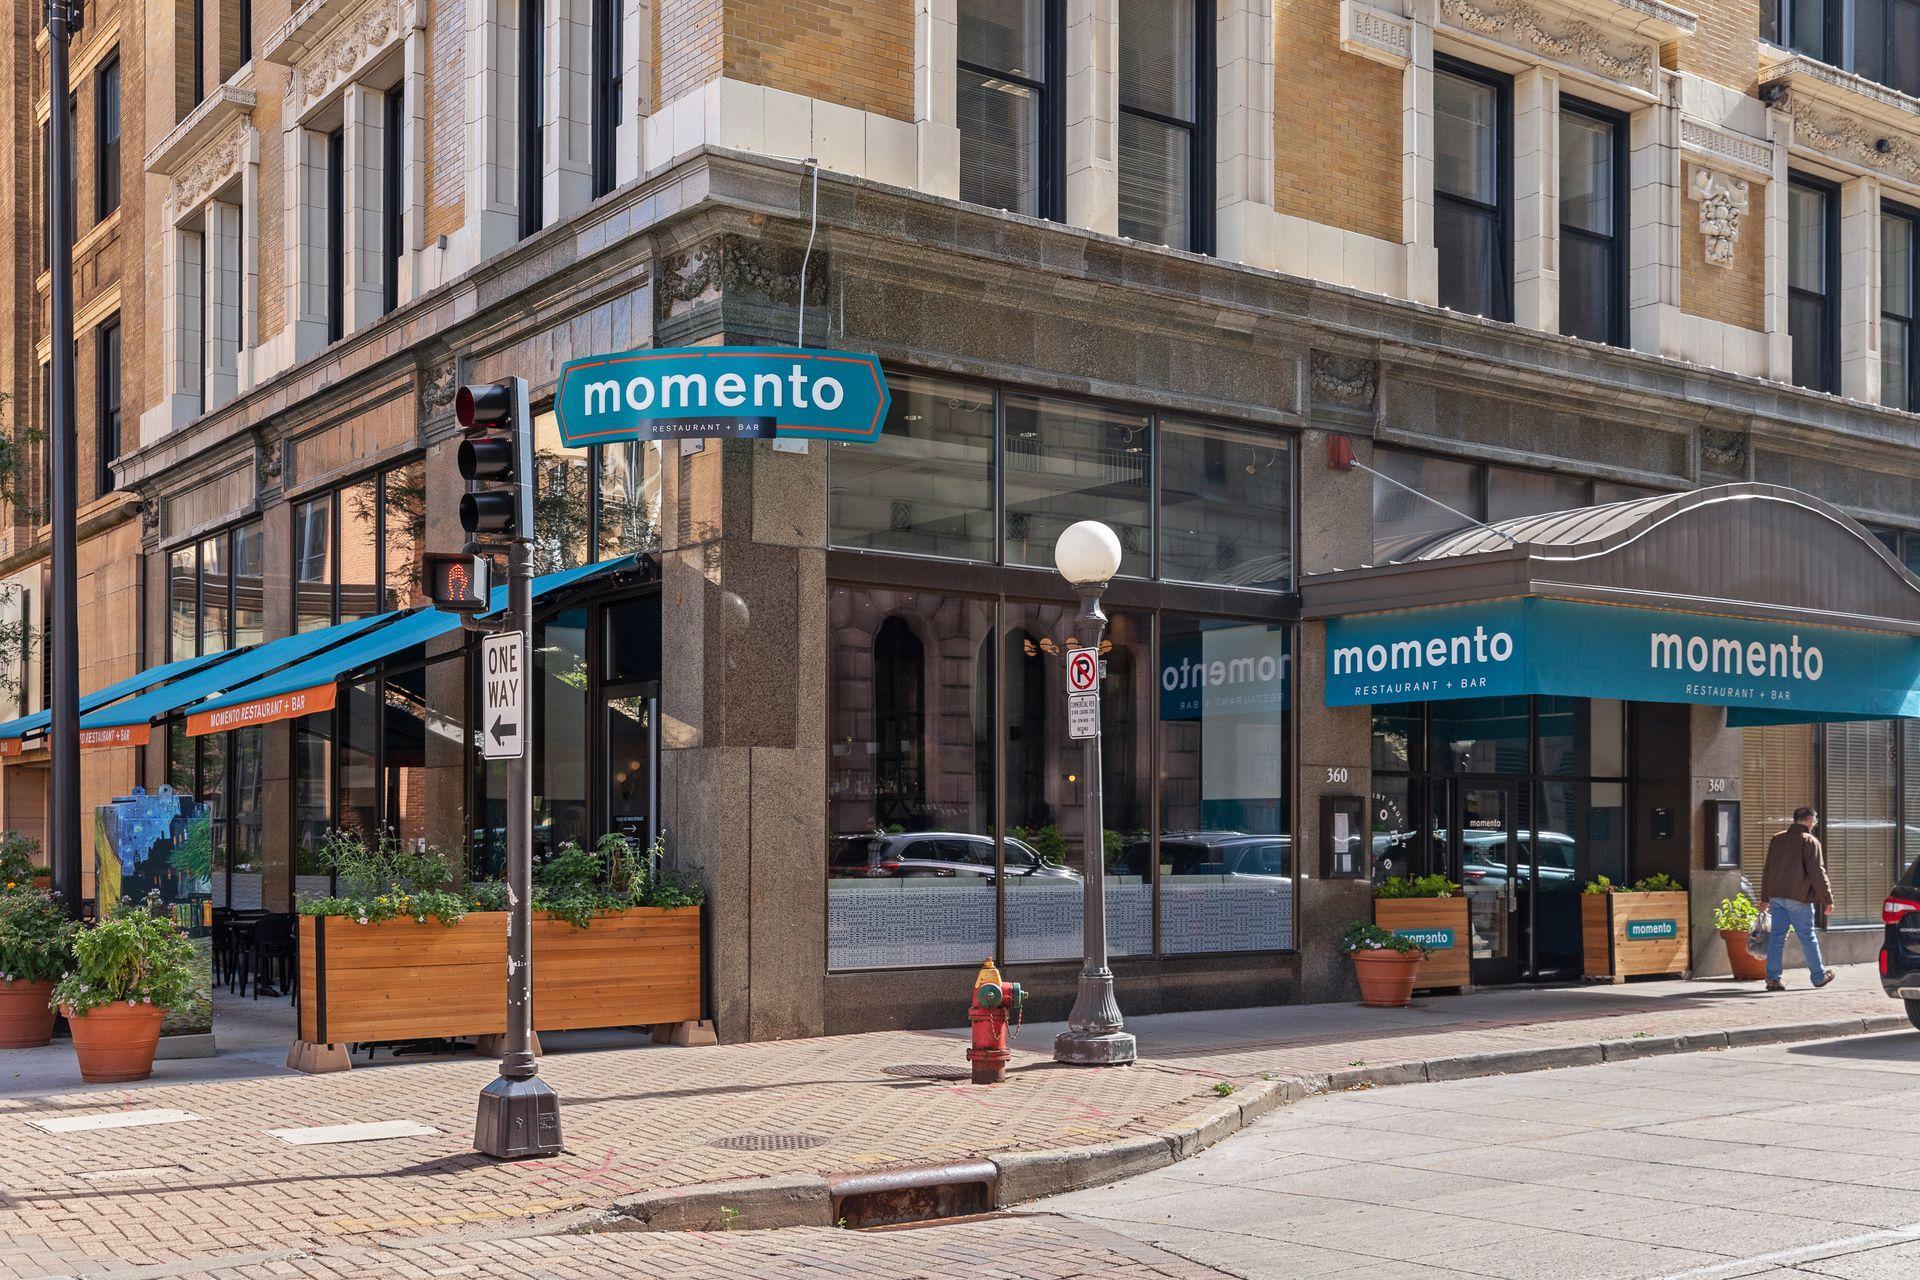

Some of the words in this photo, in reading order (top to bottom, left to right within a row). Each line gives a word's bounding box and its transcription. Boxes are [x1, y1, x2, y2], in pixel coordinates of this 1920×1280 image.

[584, 364, 844, 416] momento
[652, 423, 721, 433] RESTAURANT
[738, 423, 760, 431] BAR
[1333, 625, 1513, 675] momento
[1651, 632, 1823, 681] momento
[488, 644, 517, 675] ONE
[488, 679, 518, 708] WAY
[1355, 680, 1438, 696] RESTAURANT
[1461, 677, 1487, 688] BAR
[1685, 684, 1754, 698] RESTAURANT
[1771, 690, 1791, 700] BAR
[210, 708, 240, 728] MOMENTO
[241, 700, 283, 721] RESTAURANT
[291, 695, 305, 711] BAR
[86, 729, 114, 744] RESTAURANT
[1326, 767, 1348, 783] 360
[1708, 779, 1725, 792] 360
[1372, 792, 1386, 801] INT
[1469, 818, 1501, 828] momento
[1632, 922, 1672, 935] momento
